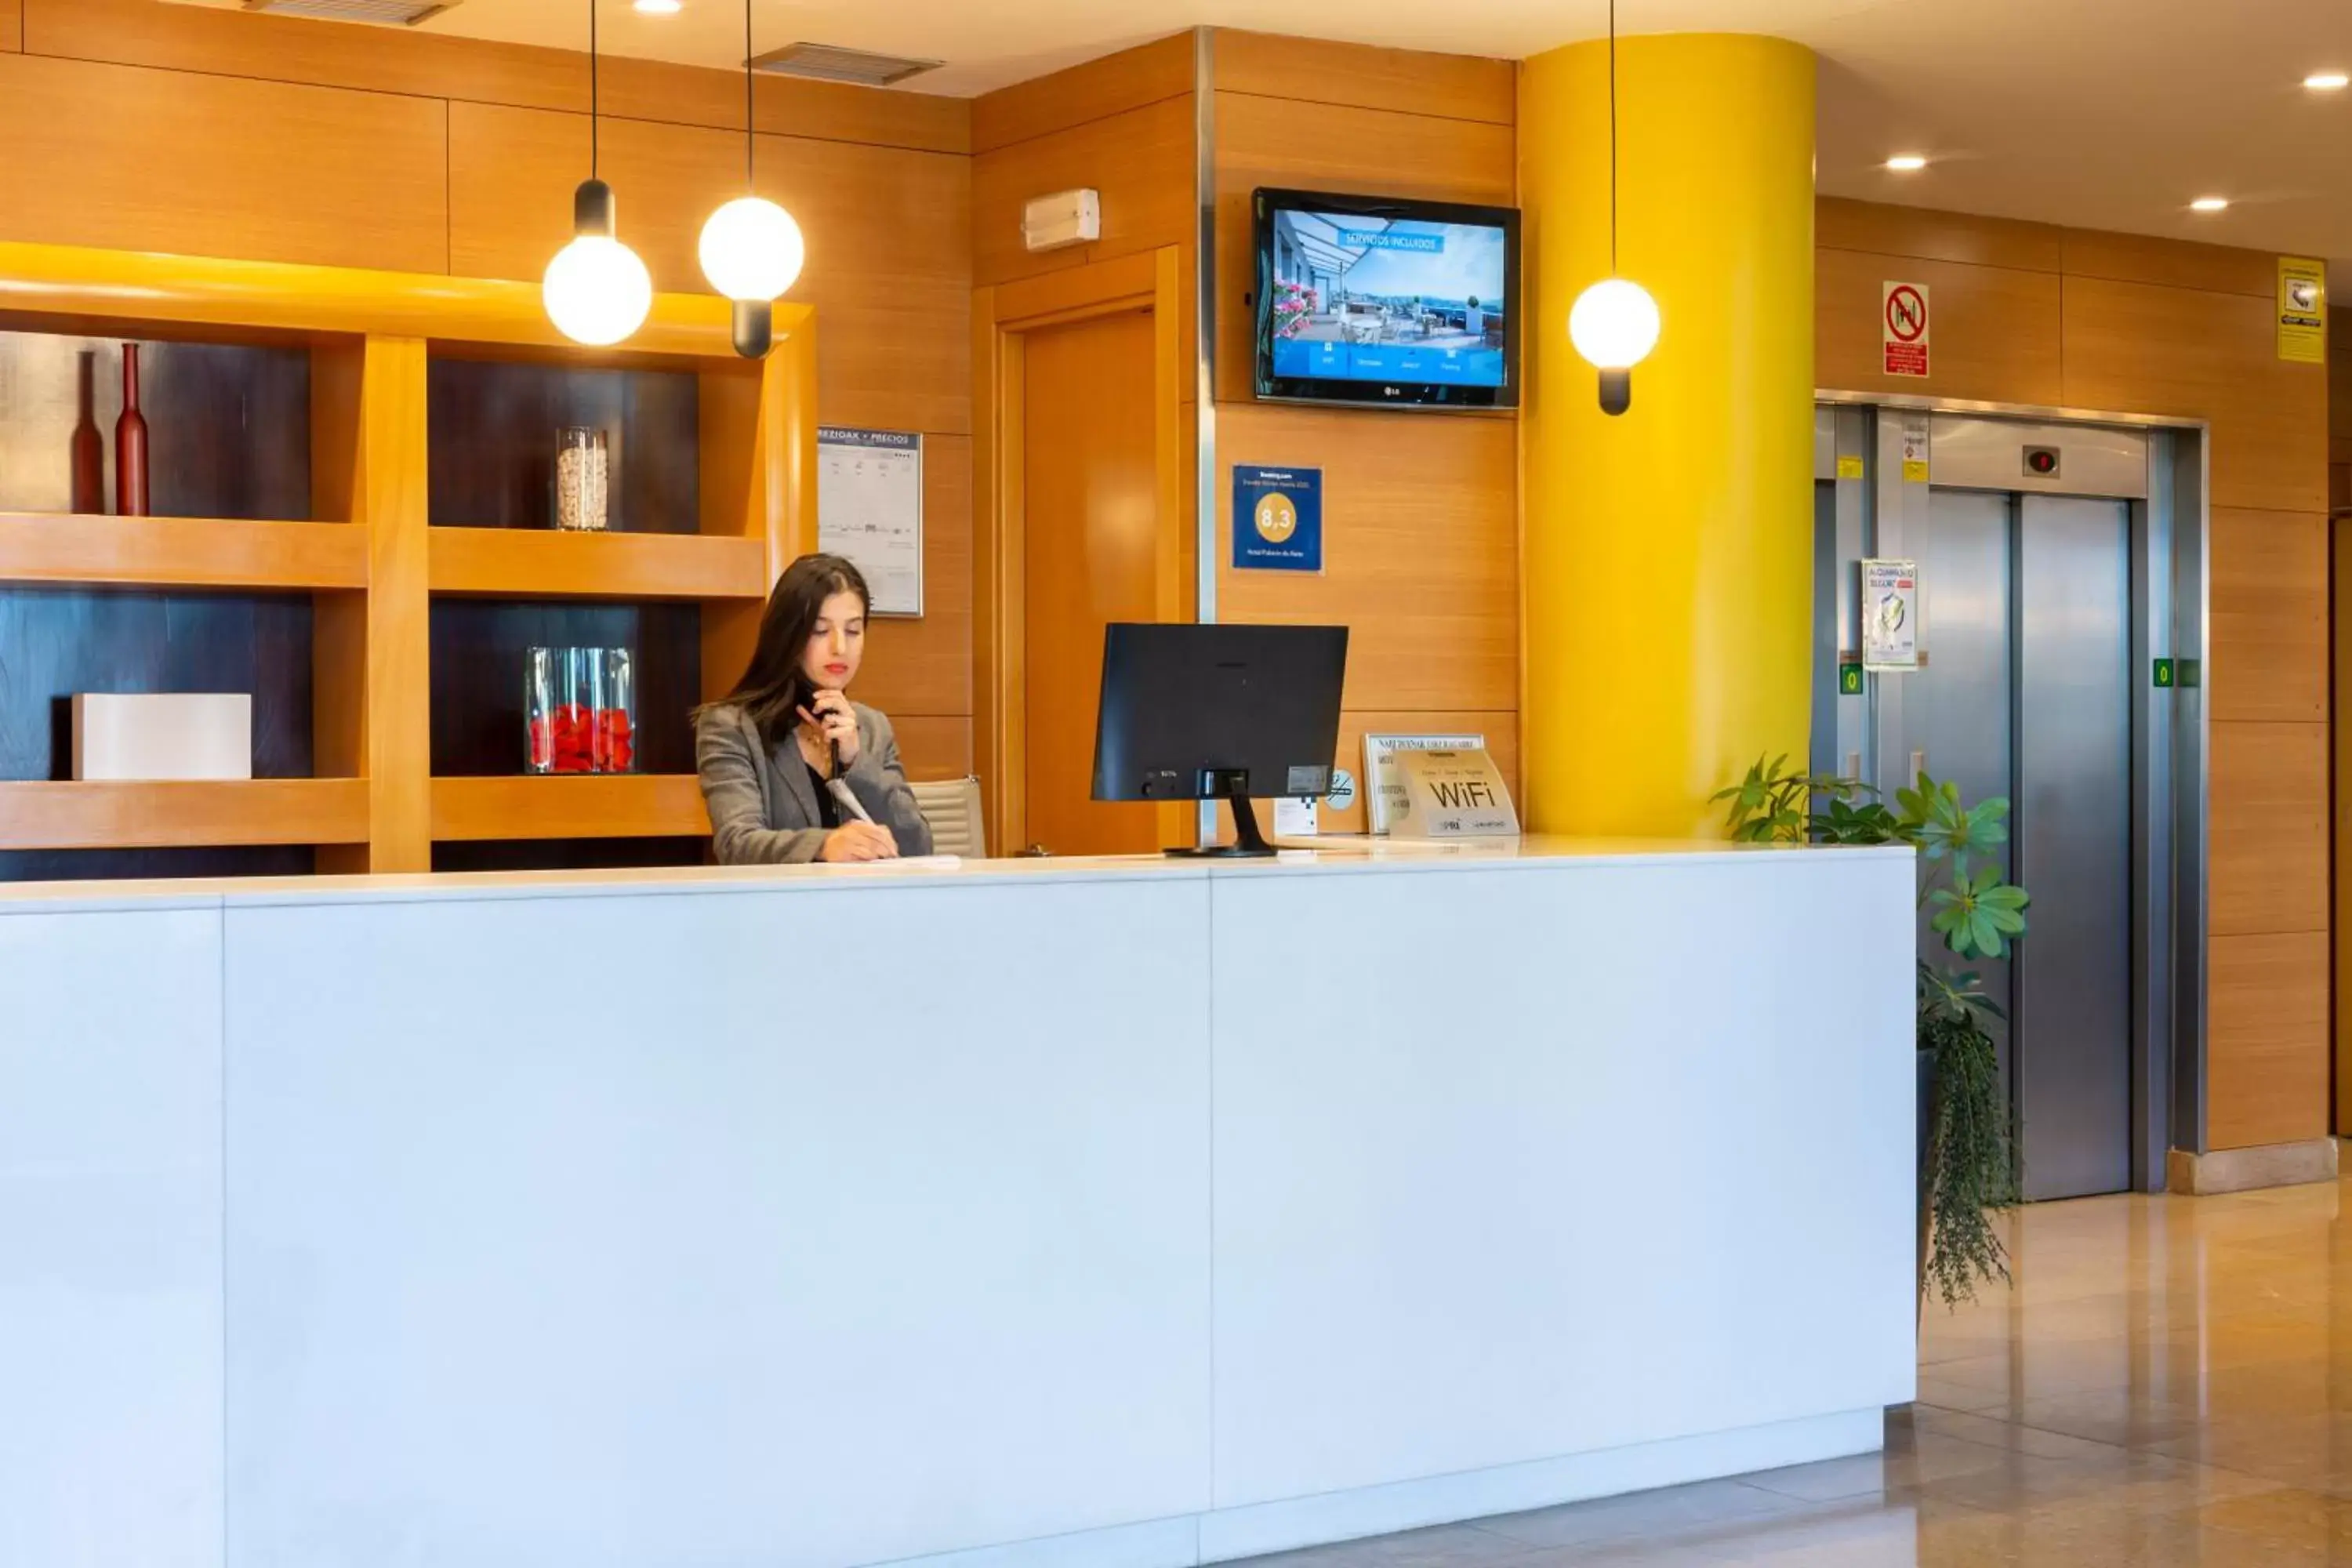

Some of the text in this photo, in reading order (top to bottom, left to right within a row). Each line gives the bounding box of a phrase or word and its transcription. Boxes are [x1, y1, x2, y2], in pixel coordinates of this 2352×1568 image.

[1261, 508, 1290, 531] 8,3
[1849, 672, 1857, 689] 0
[2160, 666, 2168, 683] 0
[1429, 782, 1495, 808] WiFi
